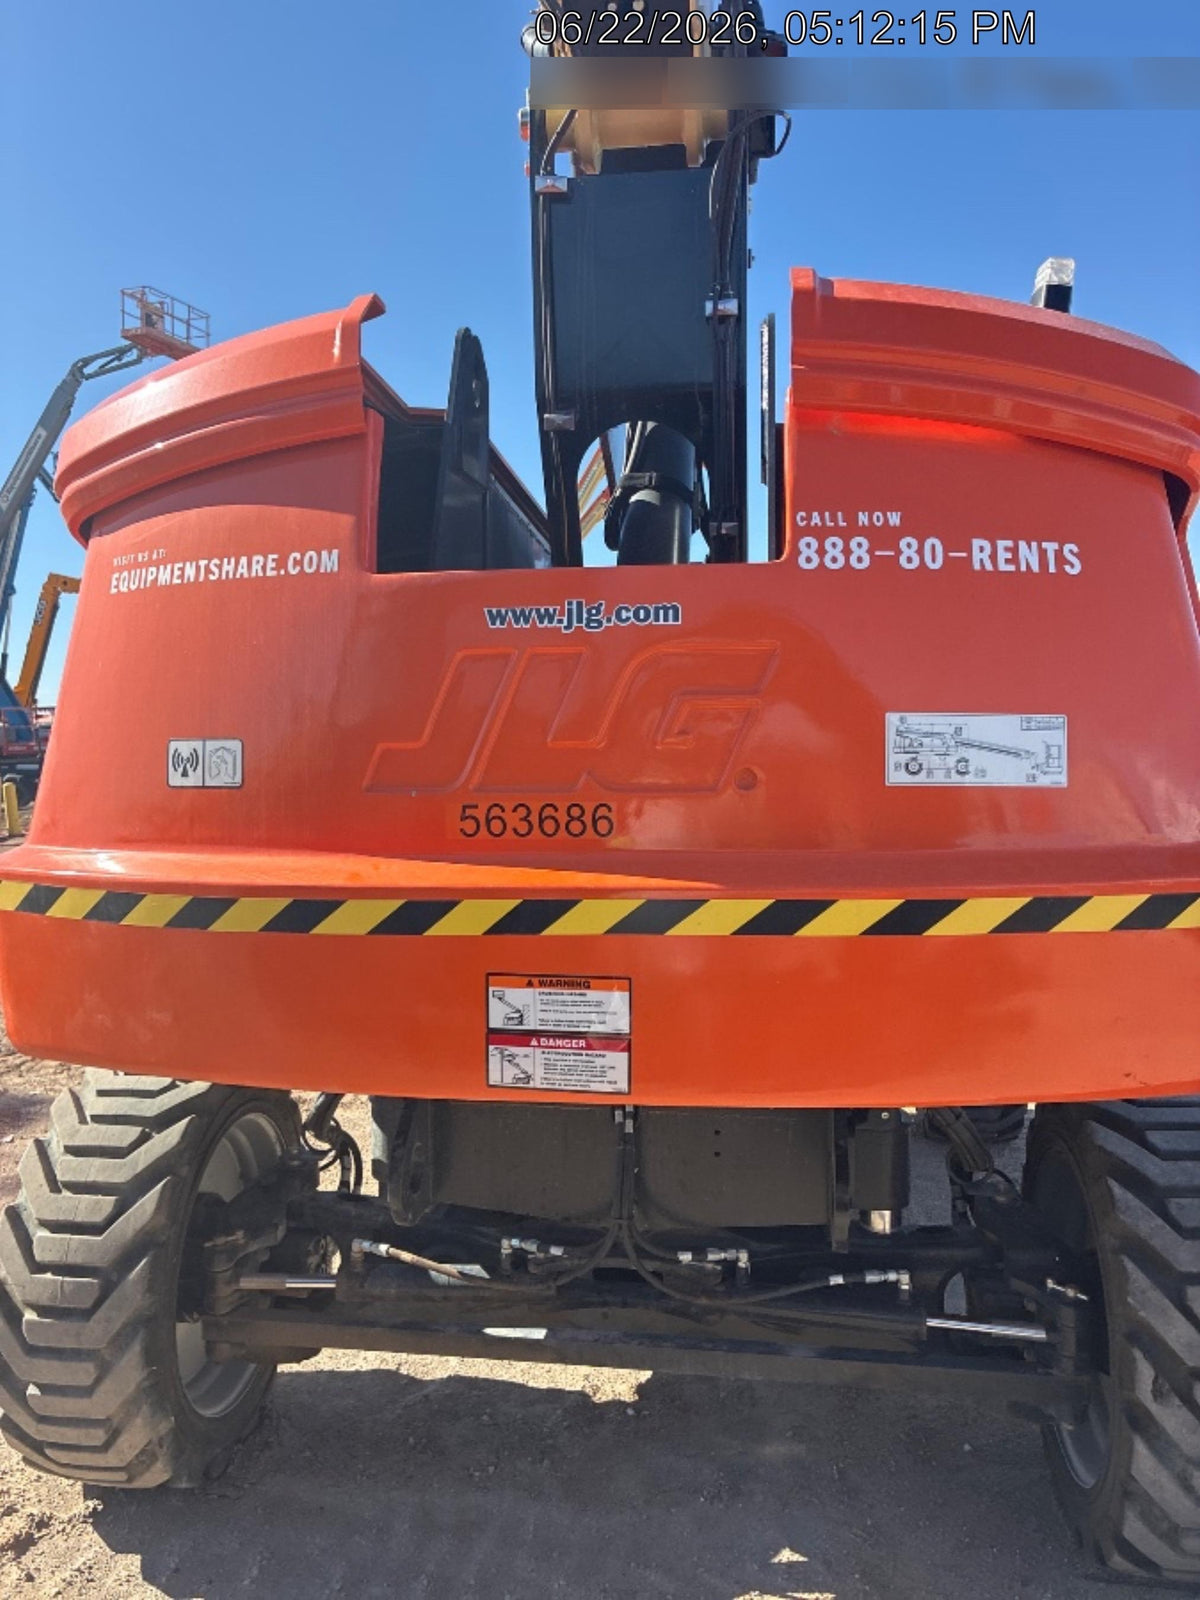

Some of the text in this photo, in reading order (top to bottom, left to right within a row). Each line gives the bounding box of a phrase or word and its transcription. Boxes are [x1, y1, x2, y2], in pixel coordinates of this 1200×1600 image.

[796, 511, 902, 527] CALL NOW
[110, 549, 339, 594] EQUIPMENTSHARE.COM
[797, 536, 1082, 576] 888-80-RENTS
[485, 599, 681, 632] www.jlg.com
[459, 803, 614, 838] 563686
[538, 979, 591, 990] WARNING
[540, 1037, 586, 1048] DANGER
